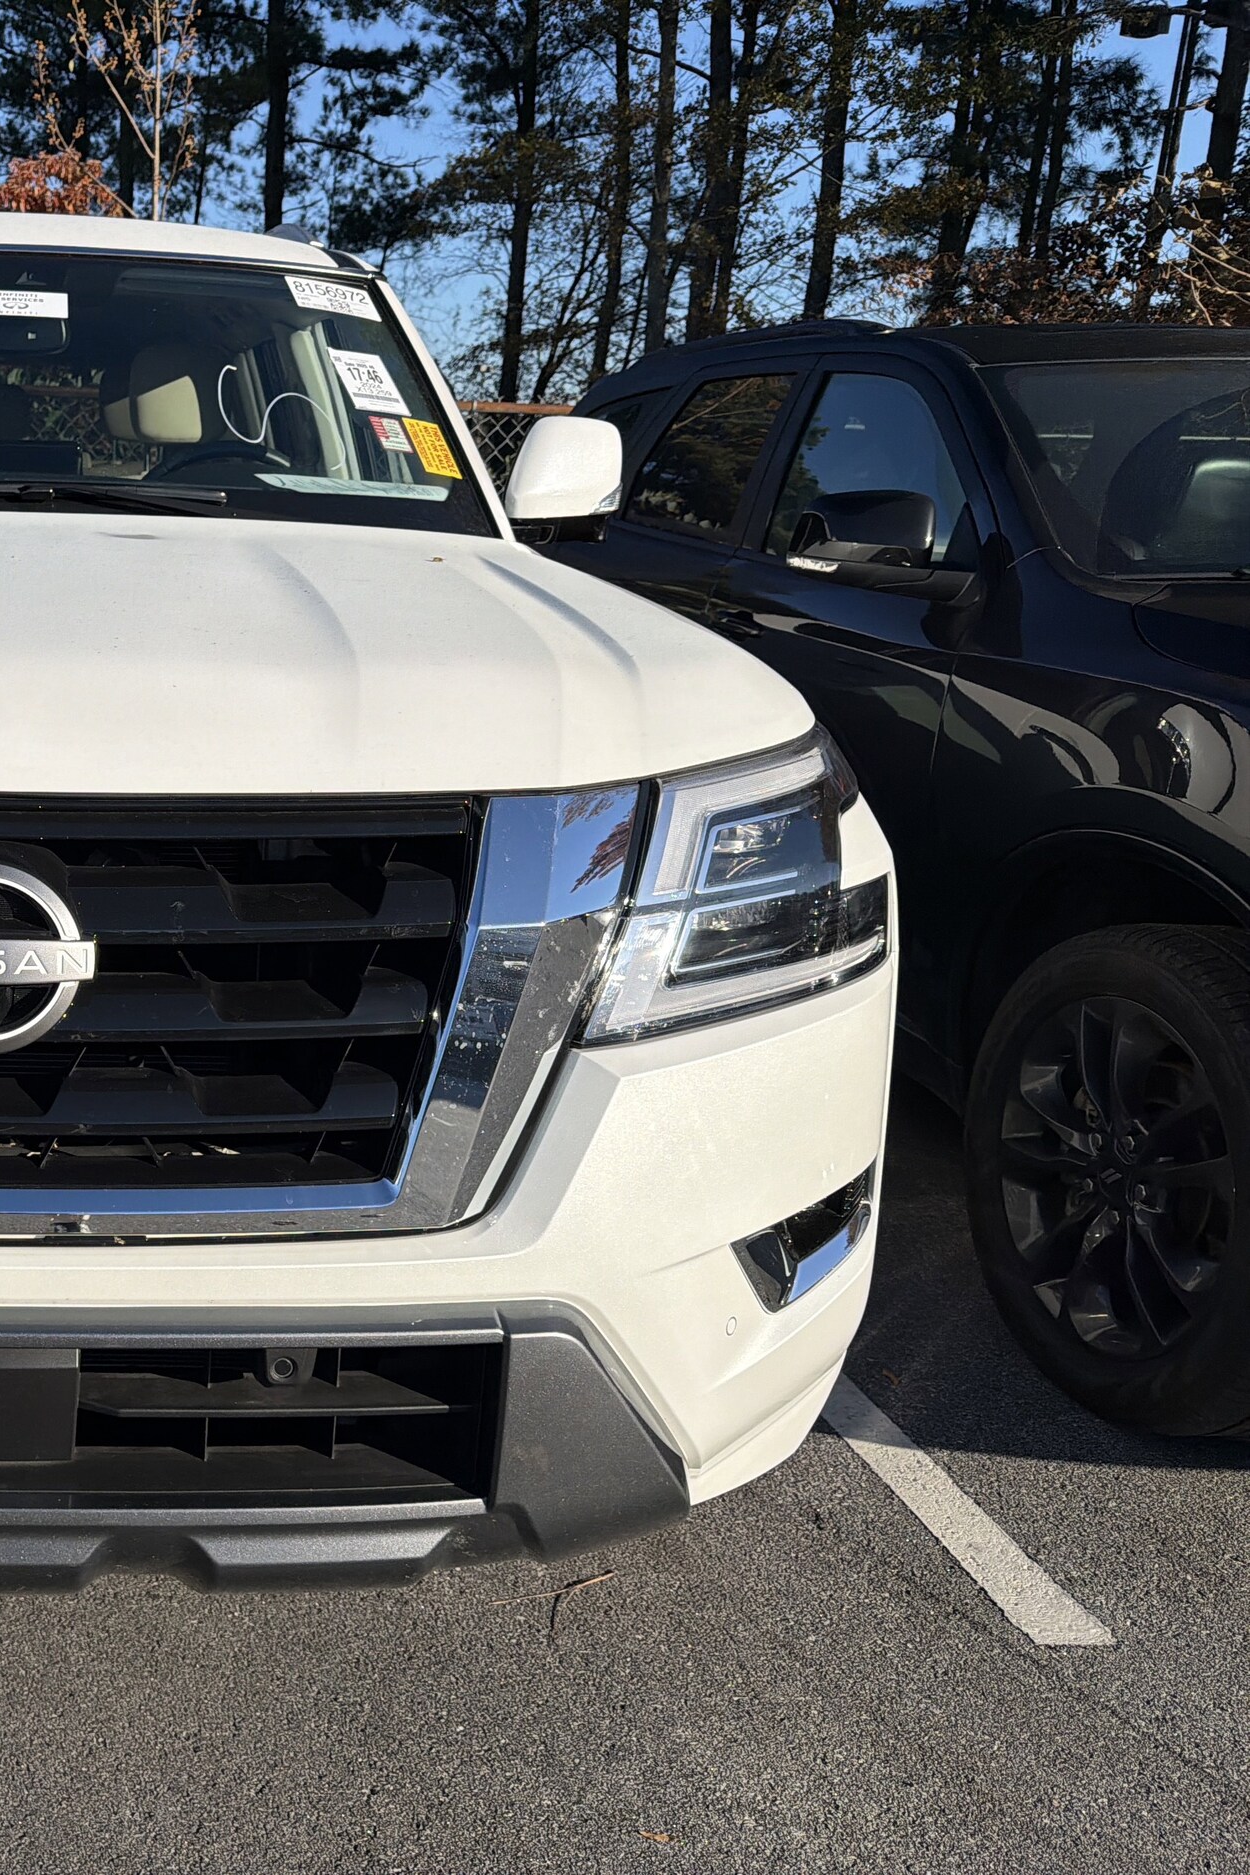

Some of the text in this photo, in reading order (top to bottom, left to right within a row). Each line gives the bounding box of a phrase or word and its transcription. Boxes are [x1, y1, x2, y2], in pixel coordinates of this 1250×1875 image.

[293, 281, 369, 305] 8156972
[422, 425, 433, 441] NOT
[429, 439, 440, 453] FOR
[435, 454, 448, 470] SALE
[430, 426, 459, 475] THIS VEHICLE
